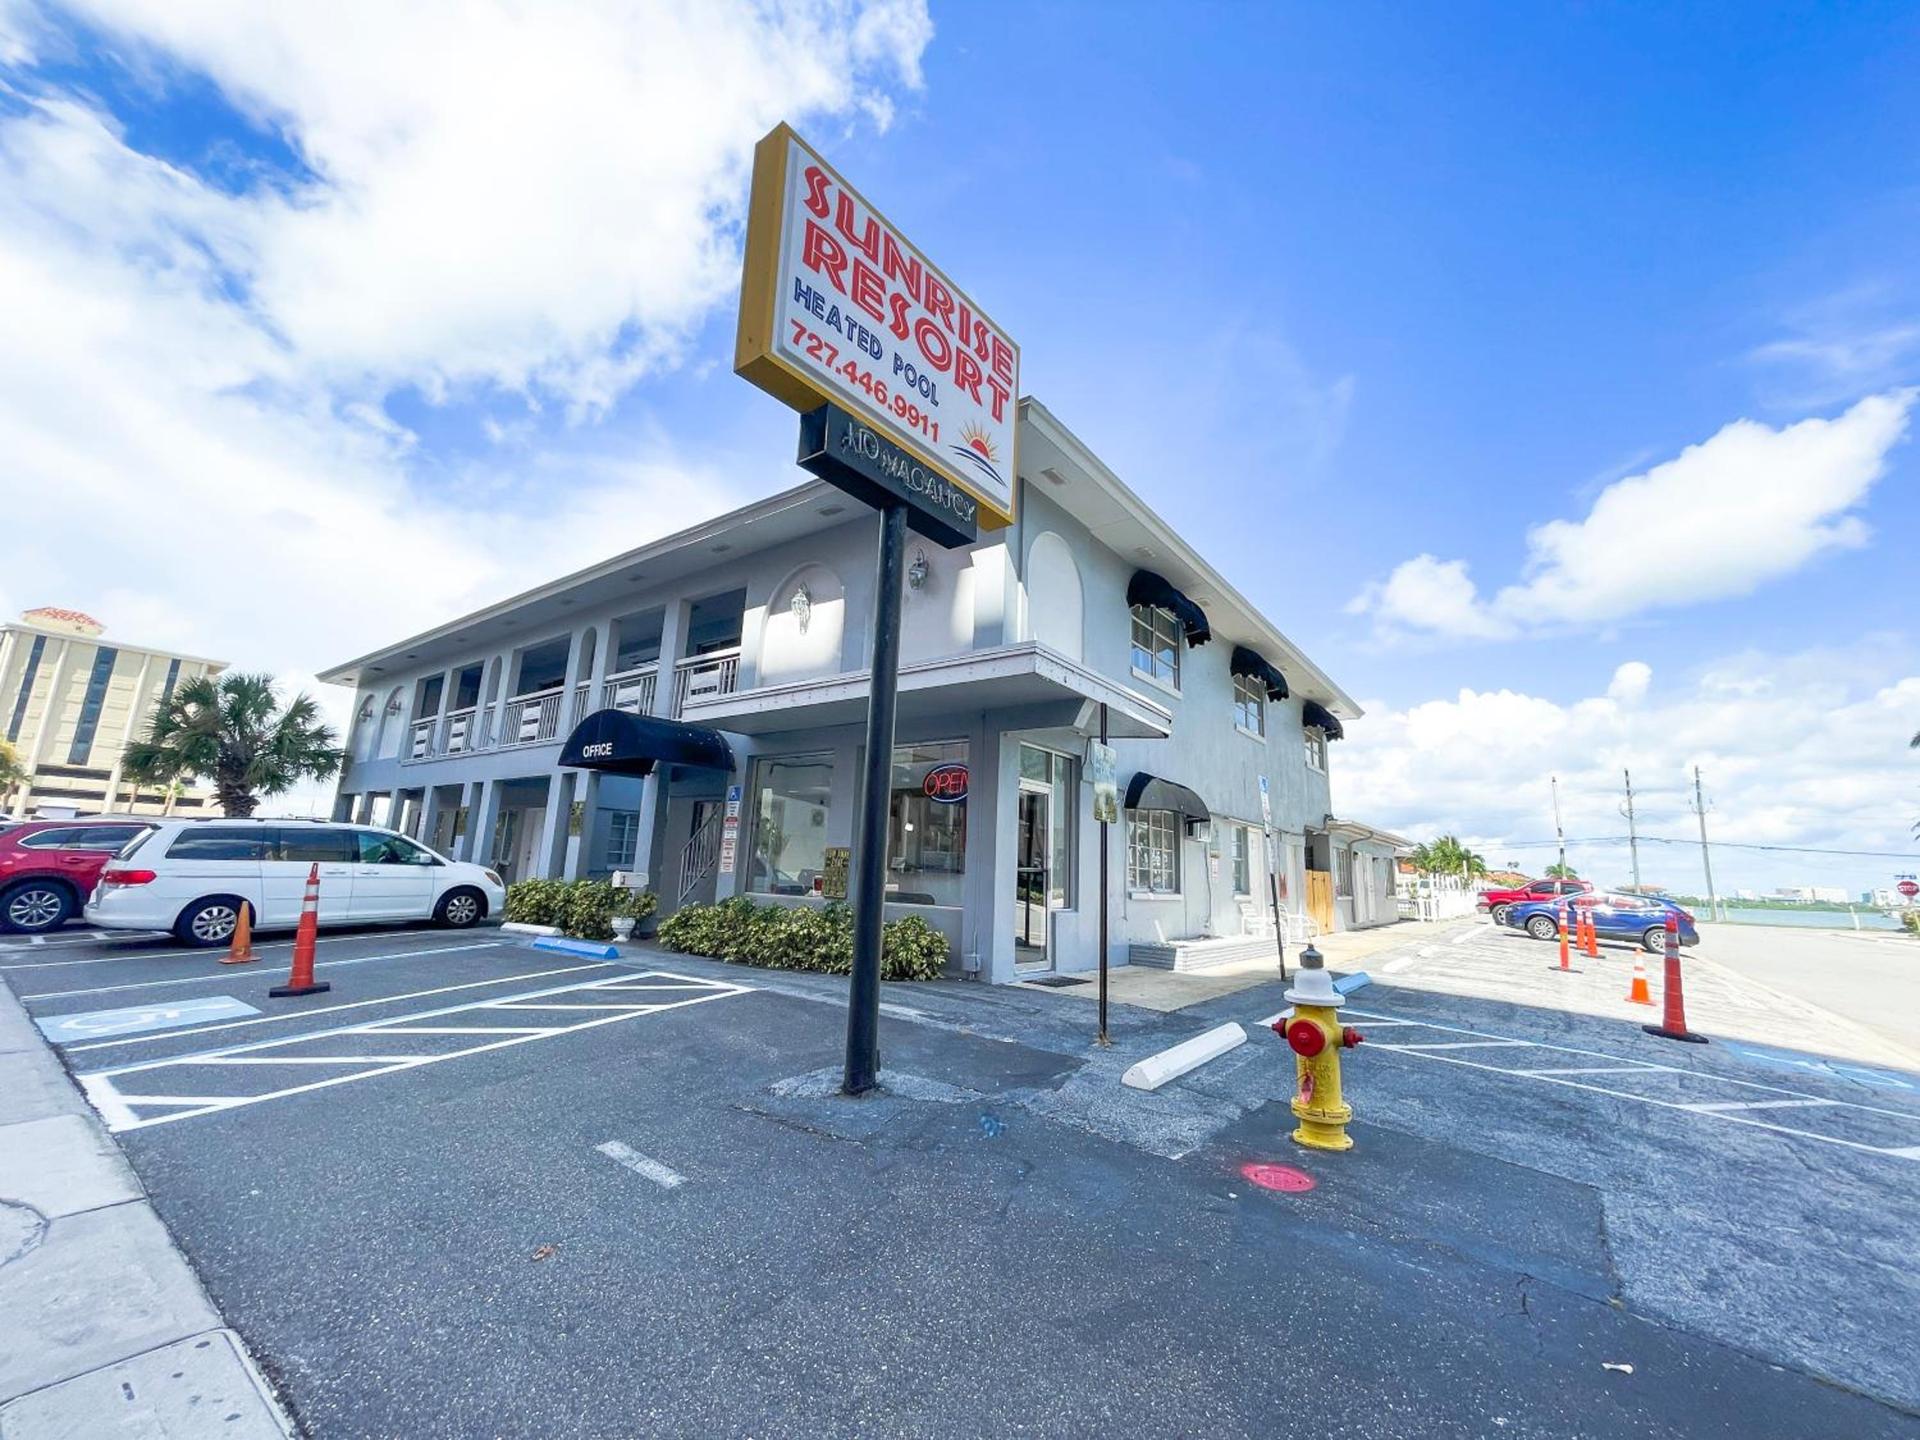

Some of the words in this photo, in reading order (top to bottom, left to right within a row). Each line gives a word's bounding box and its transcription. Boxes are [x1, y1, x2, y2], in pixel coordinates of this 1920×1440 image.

[803, 166, 1013, 387] SUNRISE
[803, 218, 1010, 424] RESORT
[791, 318, 940, 443] 727.446.9911
[794, 277, 883, 361] HEATED
[893, 352, 939, 407] POOL
[841, 422, 879, 460] NO
[880, 450, 976, 522] VACANCY
[582, 742, 613, 758] OFFICE
